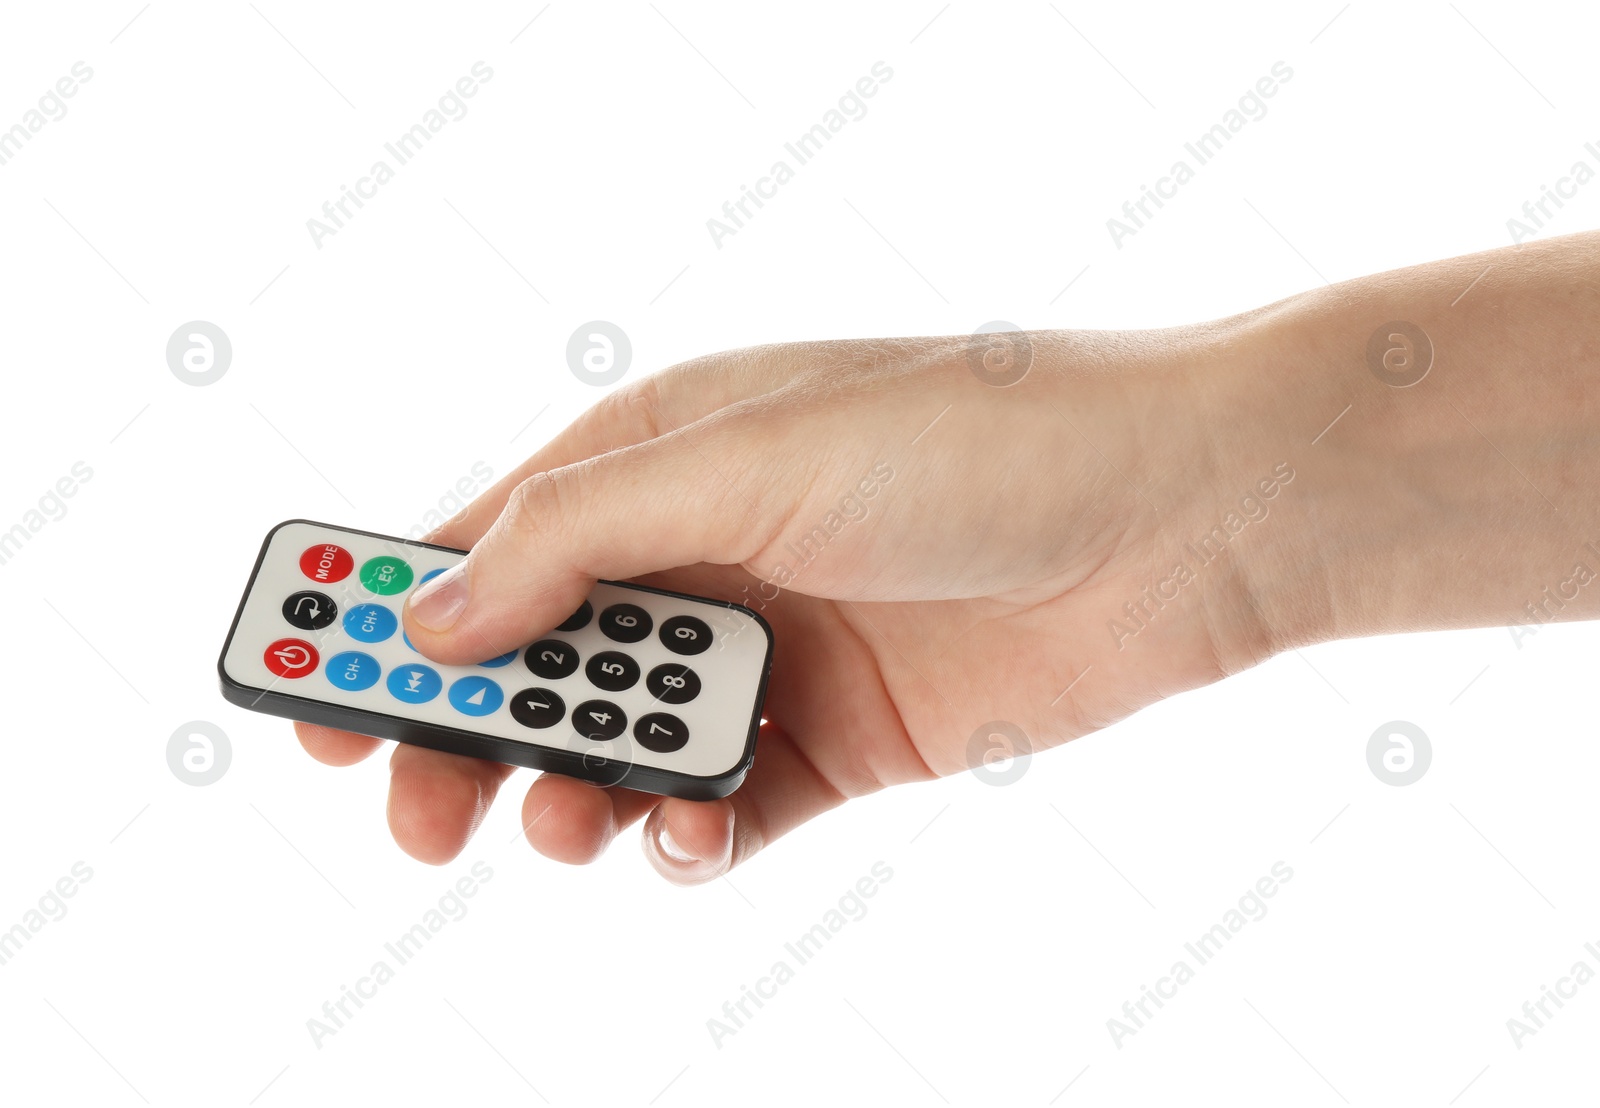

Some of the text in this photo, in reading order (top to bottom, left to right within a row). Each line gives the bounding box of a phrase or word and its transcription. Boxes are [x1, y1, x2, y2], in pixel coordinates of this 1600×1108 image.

[315, 546, 338, 580] MODE
[378, 565, 396, 583] EQ
[361, 610, 378, 633] CH+
[615, 614, 638, 628] 6
[674, 627, 698, 640] 9
[541, 650, 565, 665] 2
[601, 662, 625, 676] 5
[662, 675, 686, 689] 8
[526, 700, 550, 710] 1
[589, 711, 612, 725] 4
[649, 722, 673, 736] 7
